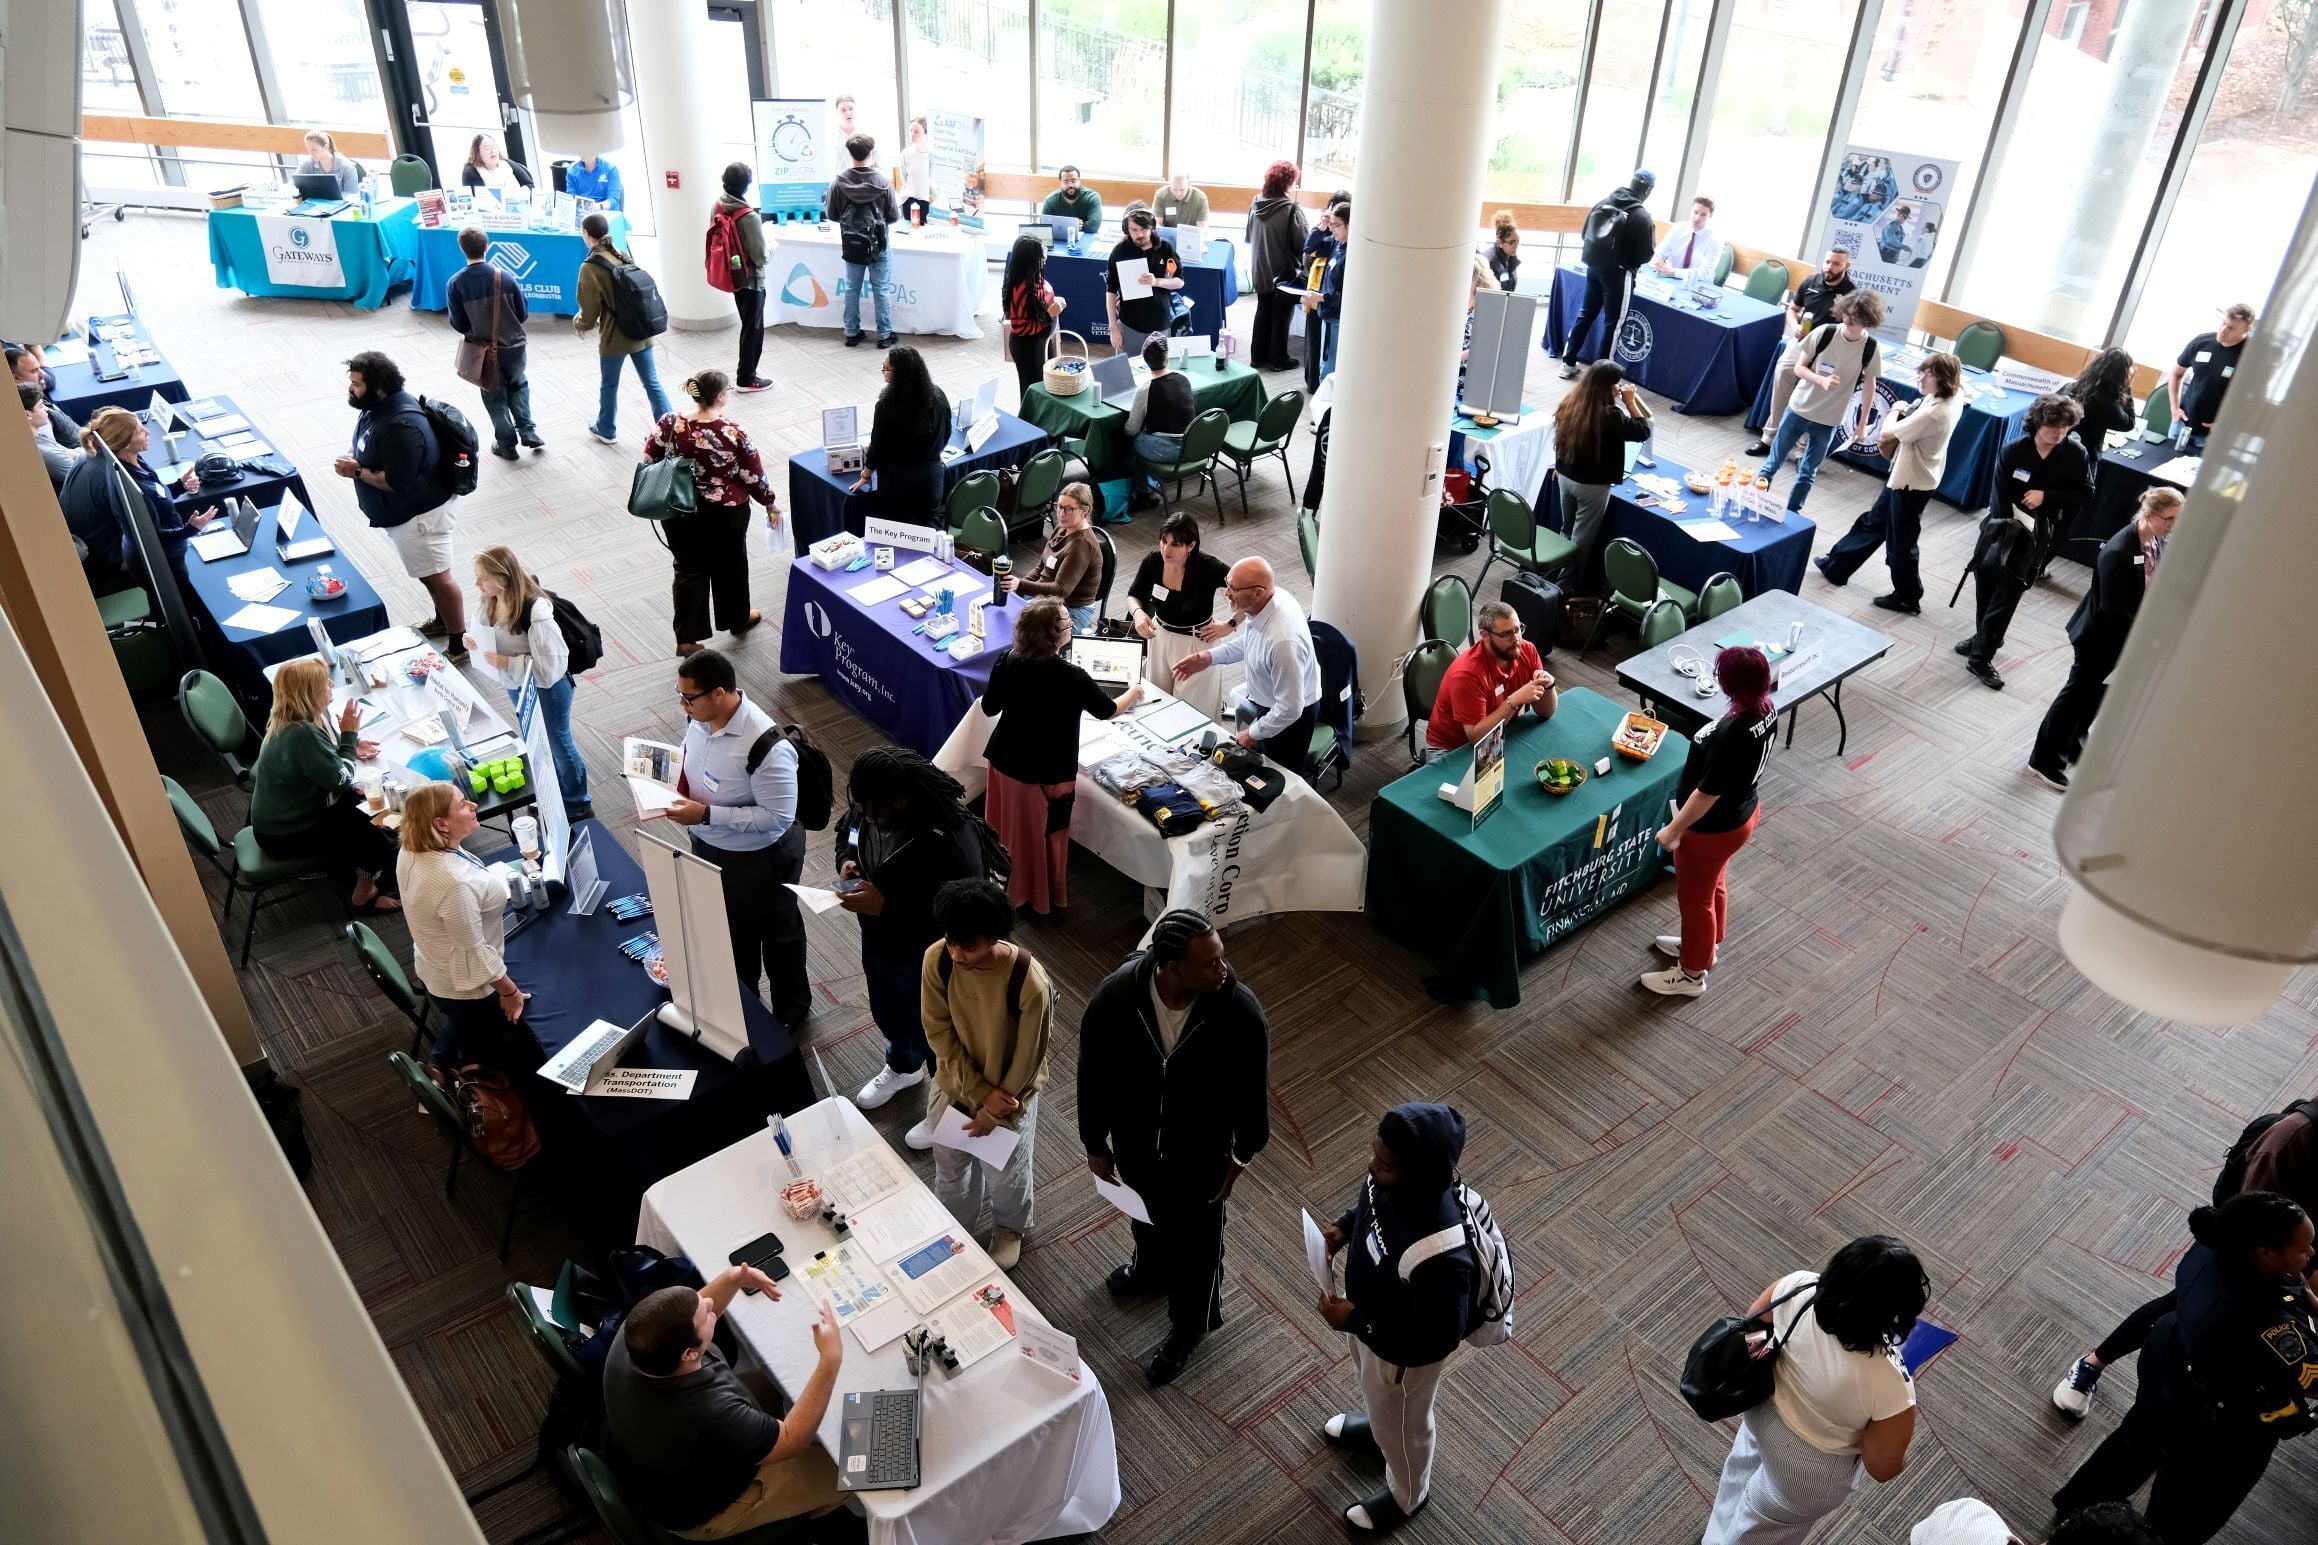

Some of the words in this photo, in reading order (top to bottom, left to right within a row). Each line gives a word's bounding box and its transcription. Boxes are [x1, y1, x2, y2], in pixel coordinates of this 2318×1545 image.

[1846, 269, 1913, 289] SACHUSETTS
[534, 284, 561, 294] CLUB
[1856, 280, 1901, 296] RTMENT
[2002, 370, 2051, 386] Commonwealth
[2005, 378, 2052, 392] Massachusetts
[869, 526, 883, 535] The
[884, 529, 898, 539] Key
[899, 531, 931, 544] Program
[1749, 720, 1766, 738] THE
[1545, 848, 1614, 898] FITCHBURG
[1617, 827, 1652, 857] STATE
[1540, 843, 1648, 916] UNIVERSITY
[1212, 864, 1241, 915] Corp
[602, 1078, 677, 1088] Transportation
[621, 1071, 682, 1080] Department
[606, 1087, 653, 1095] (MassDOT)
[2266, 1322, 2292, 1340] POLICE
